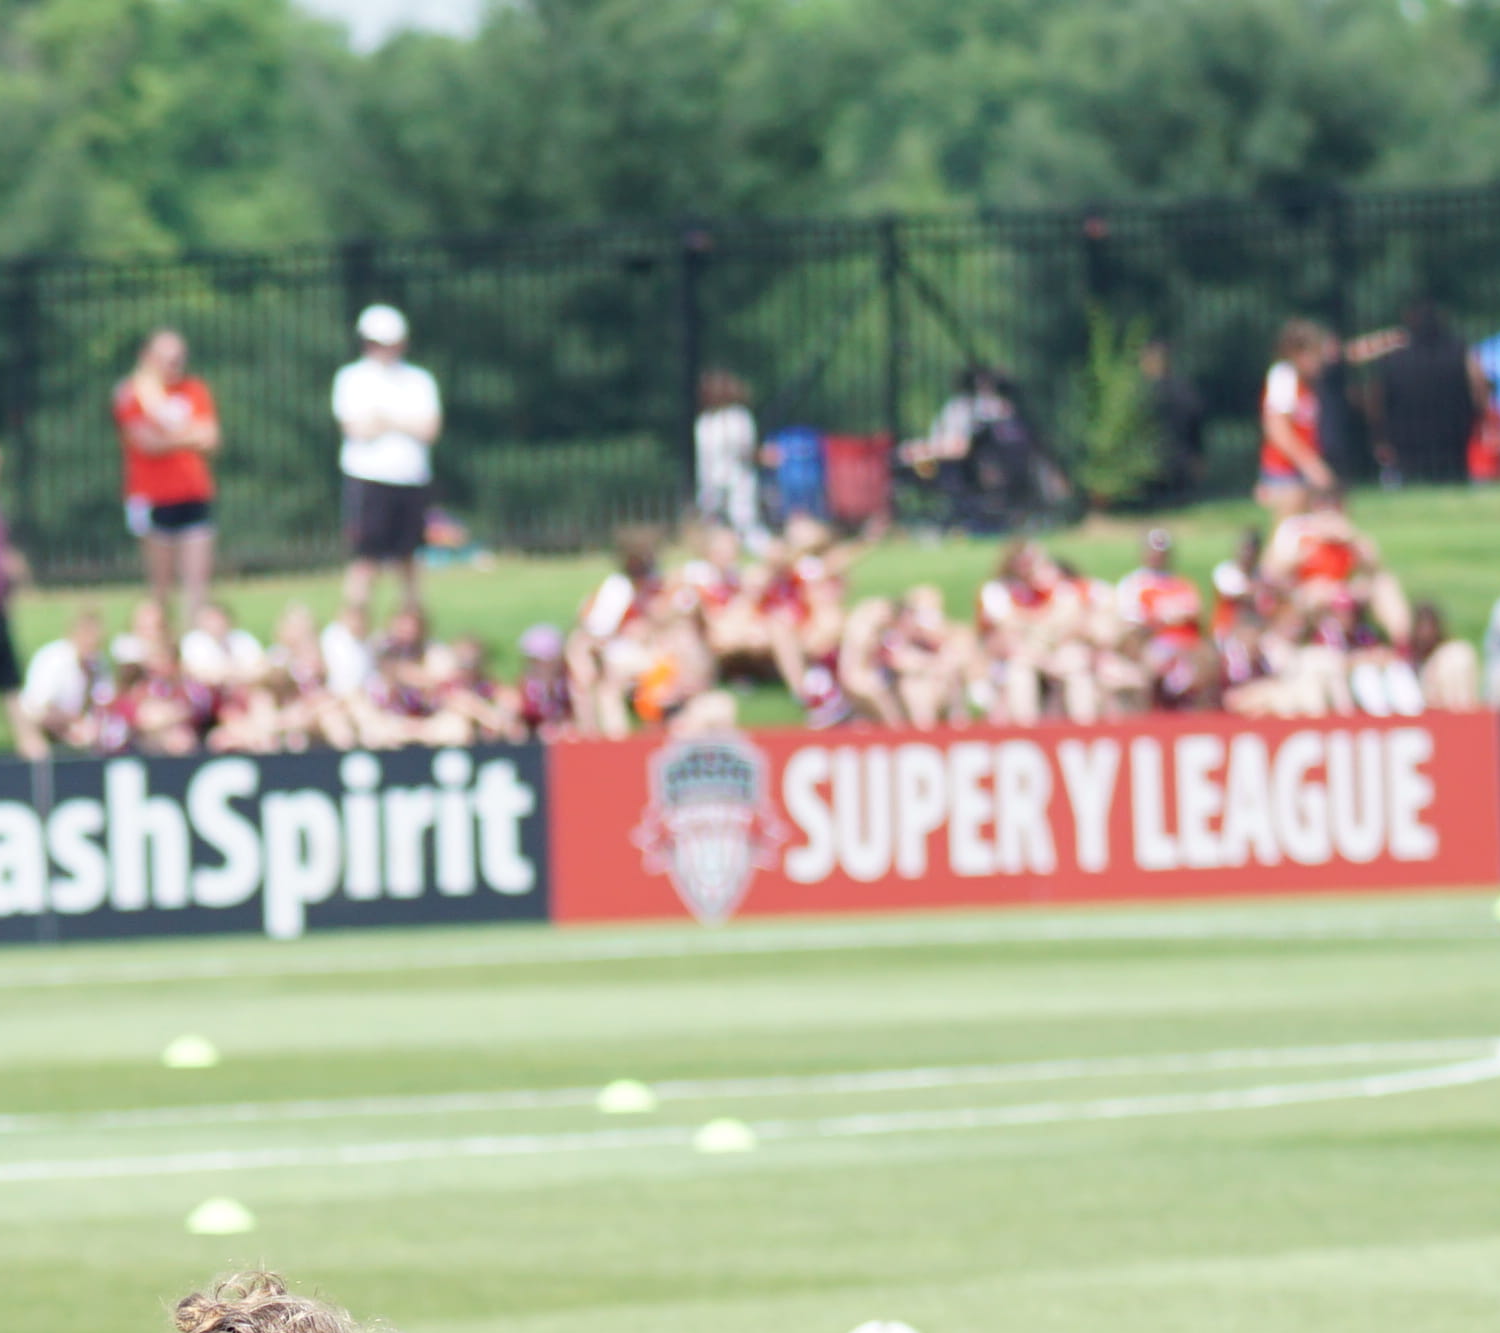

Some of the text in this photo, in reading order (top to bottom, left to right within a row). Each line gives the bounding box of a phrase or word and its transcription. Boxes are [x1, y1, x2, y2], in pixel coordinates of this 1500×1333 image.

[782, 727, 1439, 884] SUPER Y LEAGUE
